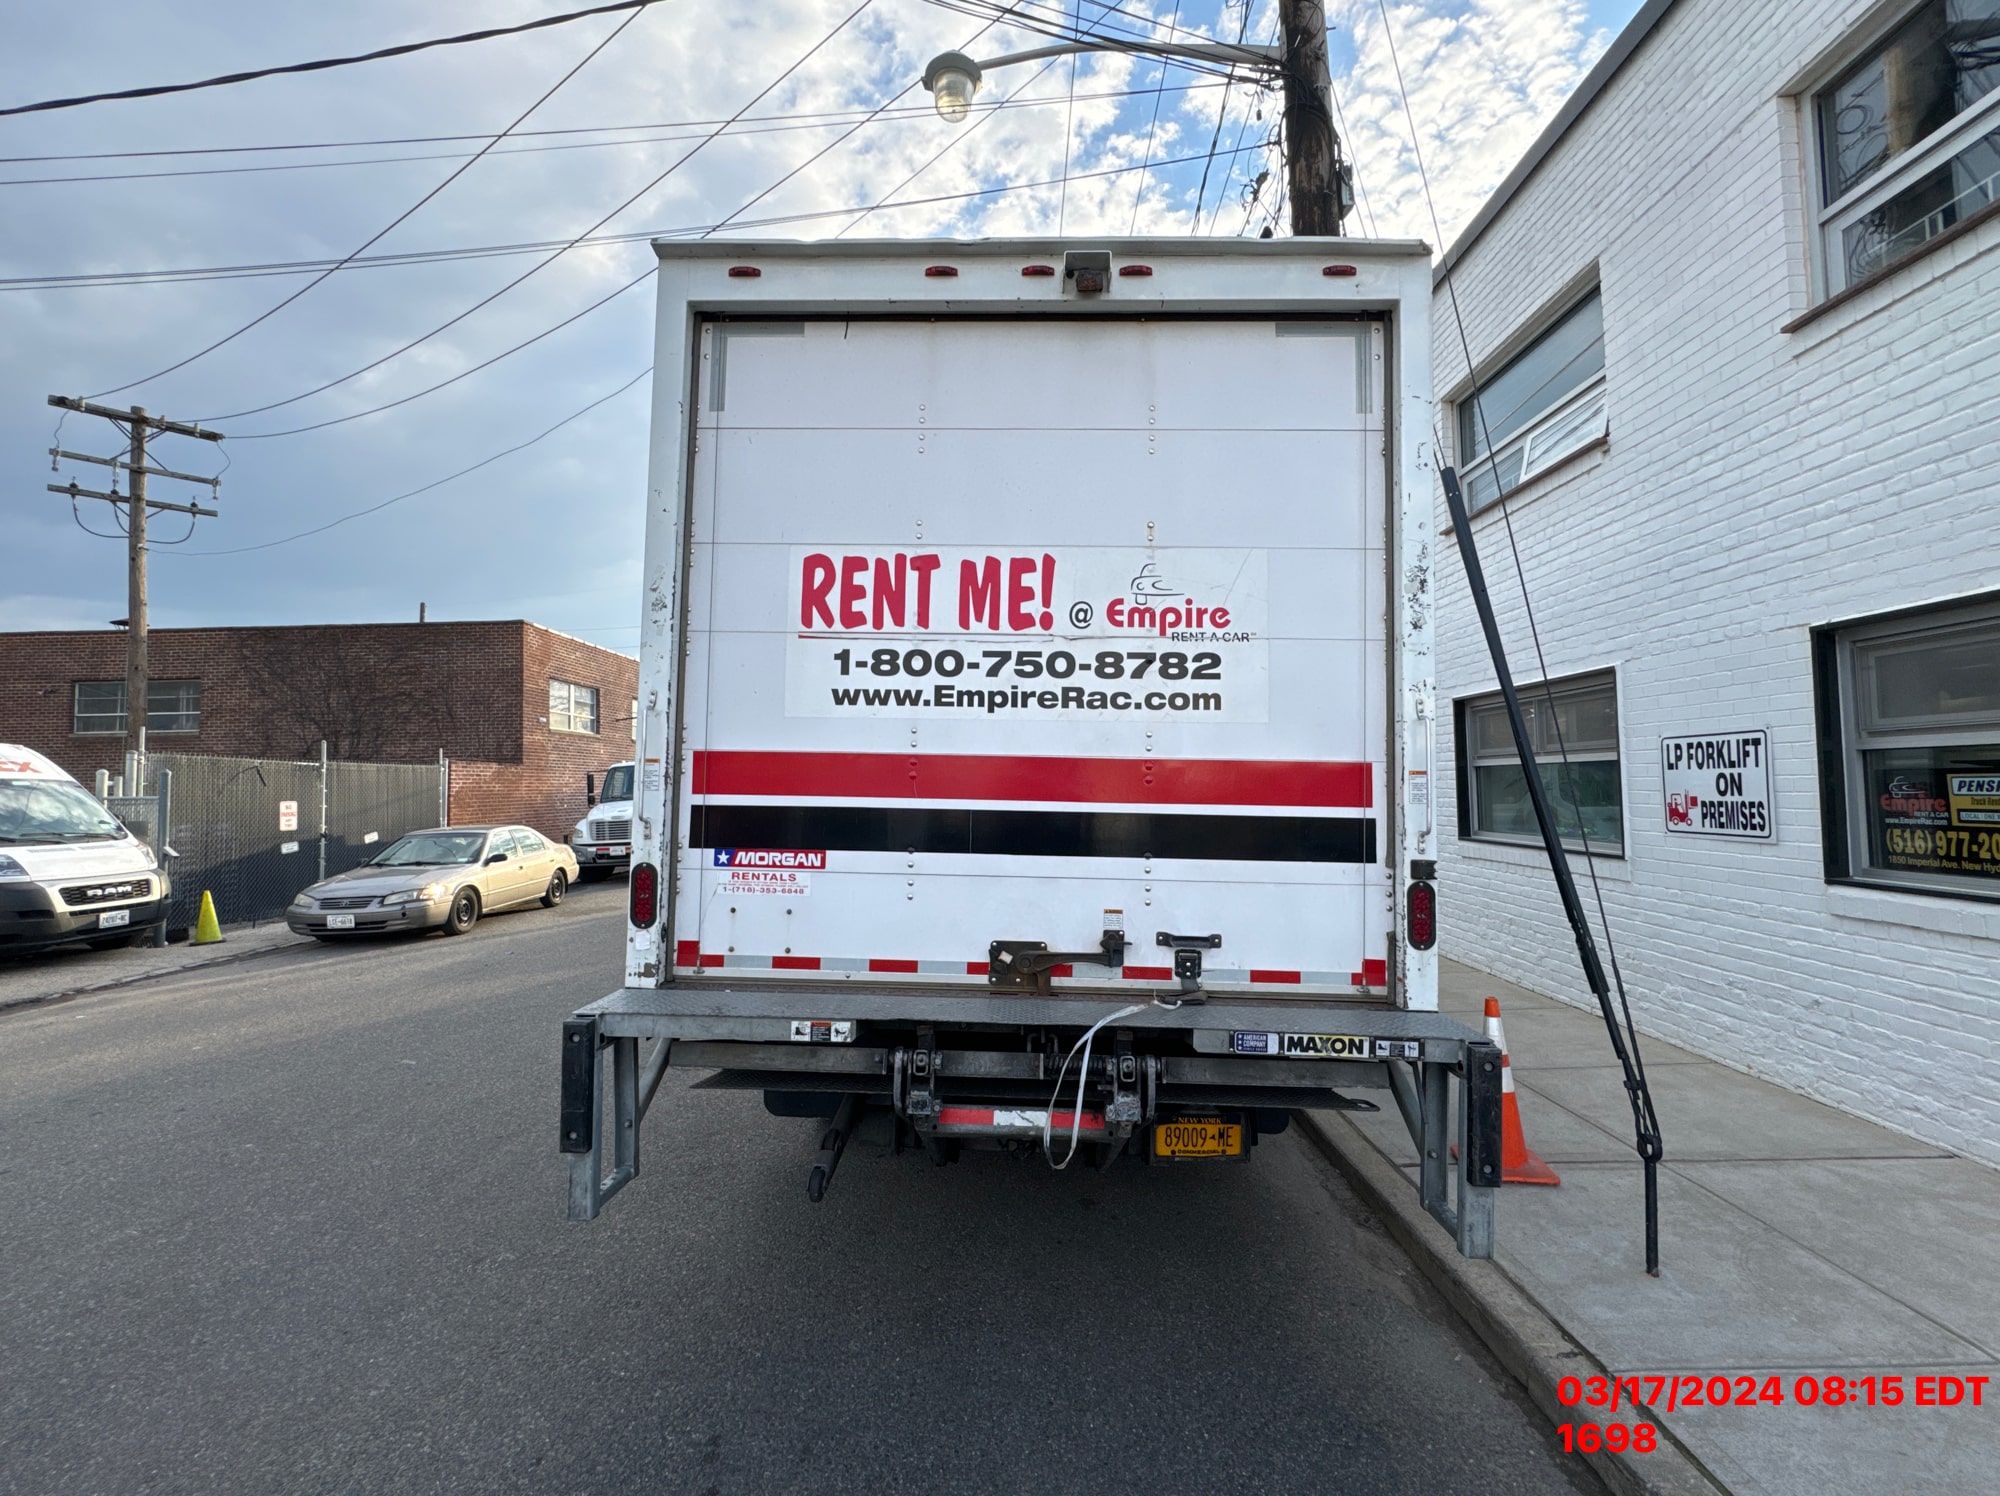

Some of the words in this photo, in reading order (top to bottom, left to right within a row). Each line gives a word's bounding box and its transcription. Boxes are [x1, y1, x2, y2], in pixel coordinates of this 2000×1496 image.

[801, 553, 940, 630] RENT
[958, 553, 1056, 631] ME!
[1069, 601, 1094, 629] @
[1106, 598, 1231, 636] Empire
[1172, 632, 1206, 642] RENT
[1209, 633, 1219, 642] A
[833, 648, 1222, 680] 1-800-750-8782
[831, 685, 1222, 713] www.EmpireRac.com
[1666, 743, 1683, 770] LP
[1686, 737, 1761, 770] FORKLIFT
[1715, 772, 1743, 797] ON
[1701, 800, 1766, 832] PREMISES
[1881, 794, 1947, 816] Empire
[1886, 828, 1932, 855] (516)
[735, 852, 821, 867] MORGAN
[1907, 857, 1940, 868] Imperial
[1961, 861, 1981, 871] New
[731, 872, 797, 882] RENTALS
[87, 885, 132, 897] RAM
[1286, 1036, 1364, 1055] MAXON
